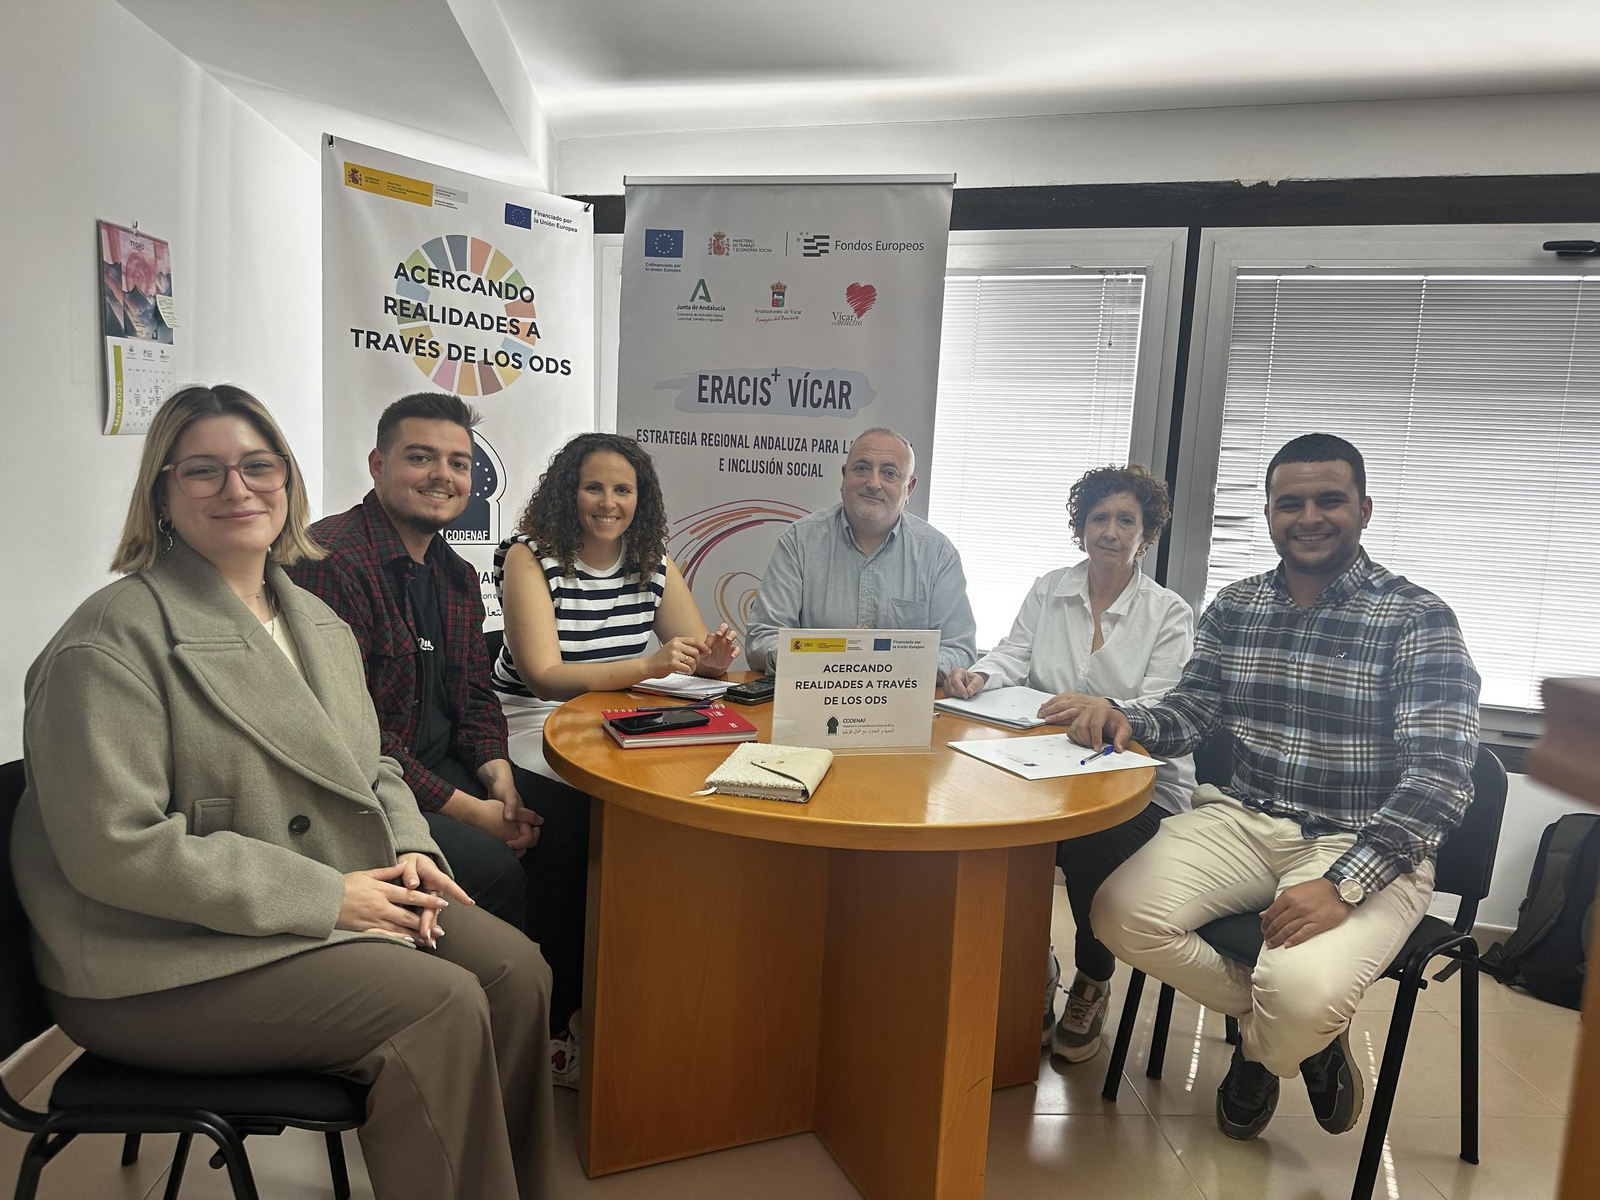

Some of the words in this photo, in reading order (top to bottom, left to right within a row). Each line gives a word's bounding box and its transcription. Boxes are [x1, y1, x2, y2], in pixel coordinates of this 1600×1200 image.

[534, 210, 562, 222] Financiado
[540, 219, 555, 227] Unión
[556, 222, 578, 232] Europea
[835, 240, 874, 251] Fondos
[876, 240, 925, 253] Europeos
[394, 262, 535, 304] ACERCANDO
[384, 296, 520, 336] REALIDADES
[526, 322, 541, 339] A
[832, 312, 855, 321] Vícar
[350, 328, 441, 359] TRAVÉS
[447, 343, 476, 364] DE
[483, 348, 523, 370] LOS
[528, 356, 572, 376] ODS
[788, 372, 853, 410] VÍCAR
[114, 406, 122, 427] Mayo
[636, 429, 697, 446] ESTRATEGIA
[701, 432, 750, 449] REGIONAL
[753, 436, 808, 452] ANDALUZA
[811, 438, 839, 454] PARA
[719, 458, 725, 471] E
[728, 458, 783, 475] INCLUSIÓN
[787, 462, 824, 478] SOCIAL
[446, 530, 488, 541] CODENAF
[823, 664, 893, 673] ACERCANDO
[796, 680, 863, 690] REALIDADES
[866, 680, 874, 689] A
[877, 678, 918, 689] TRAVÉS
[824, 696, 838, 705] DE
[842, 696, 862, 705] LOS
[864, 696, 888, 705] ODS
